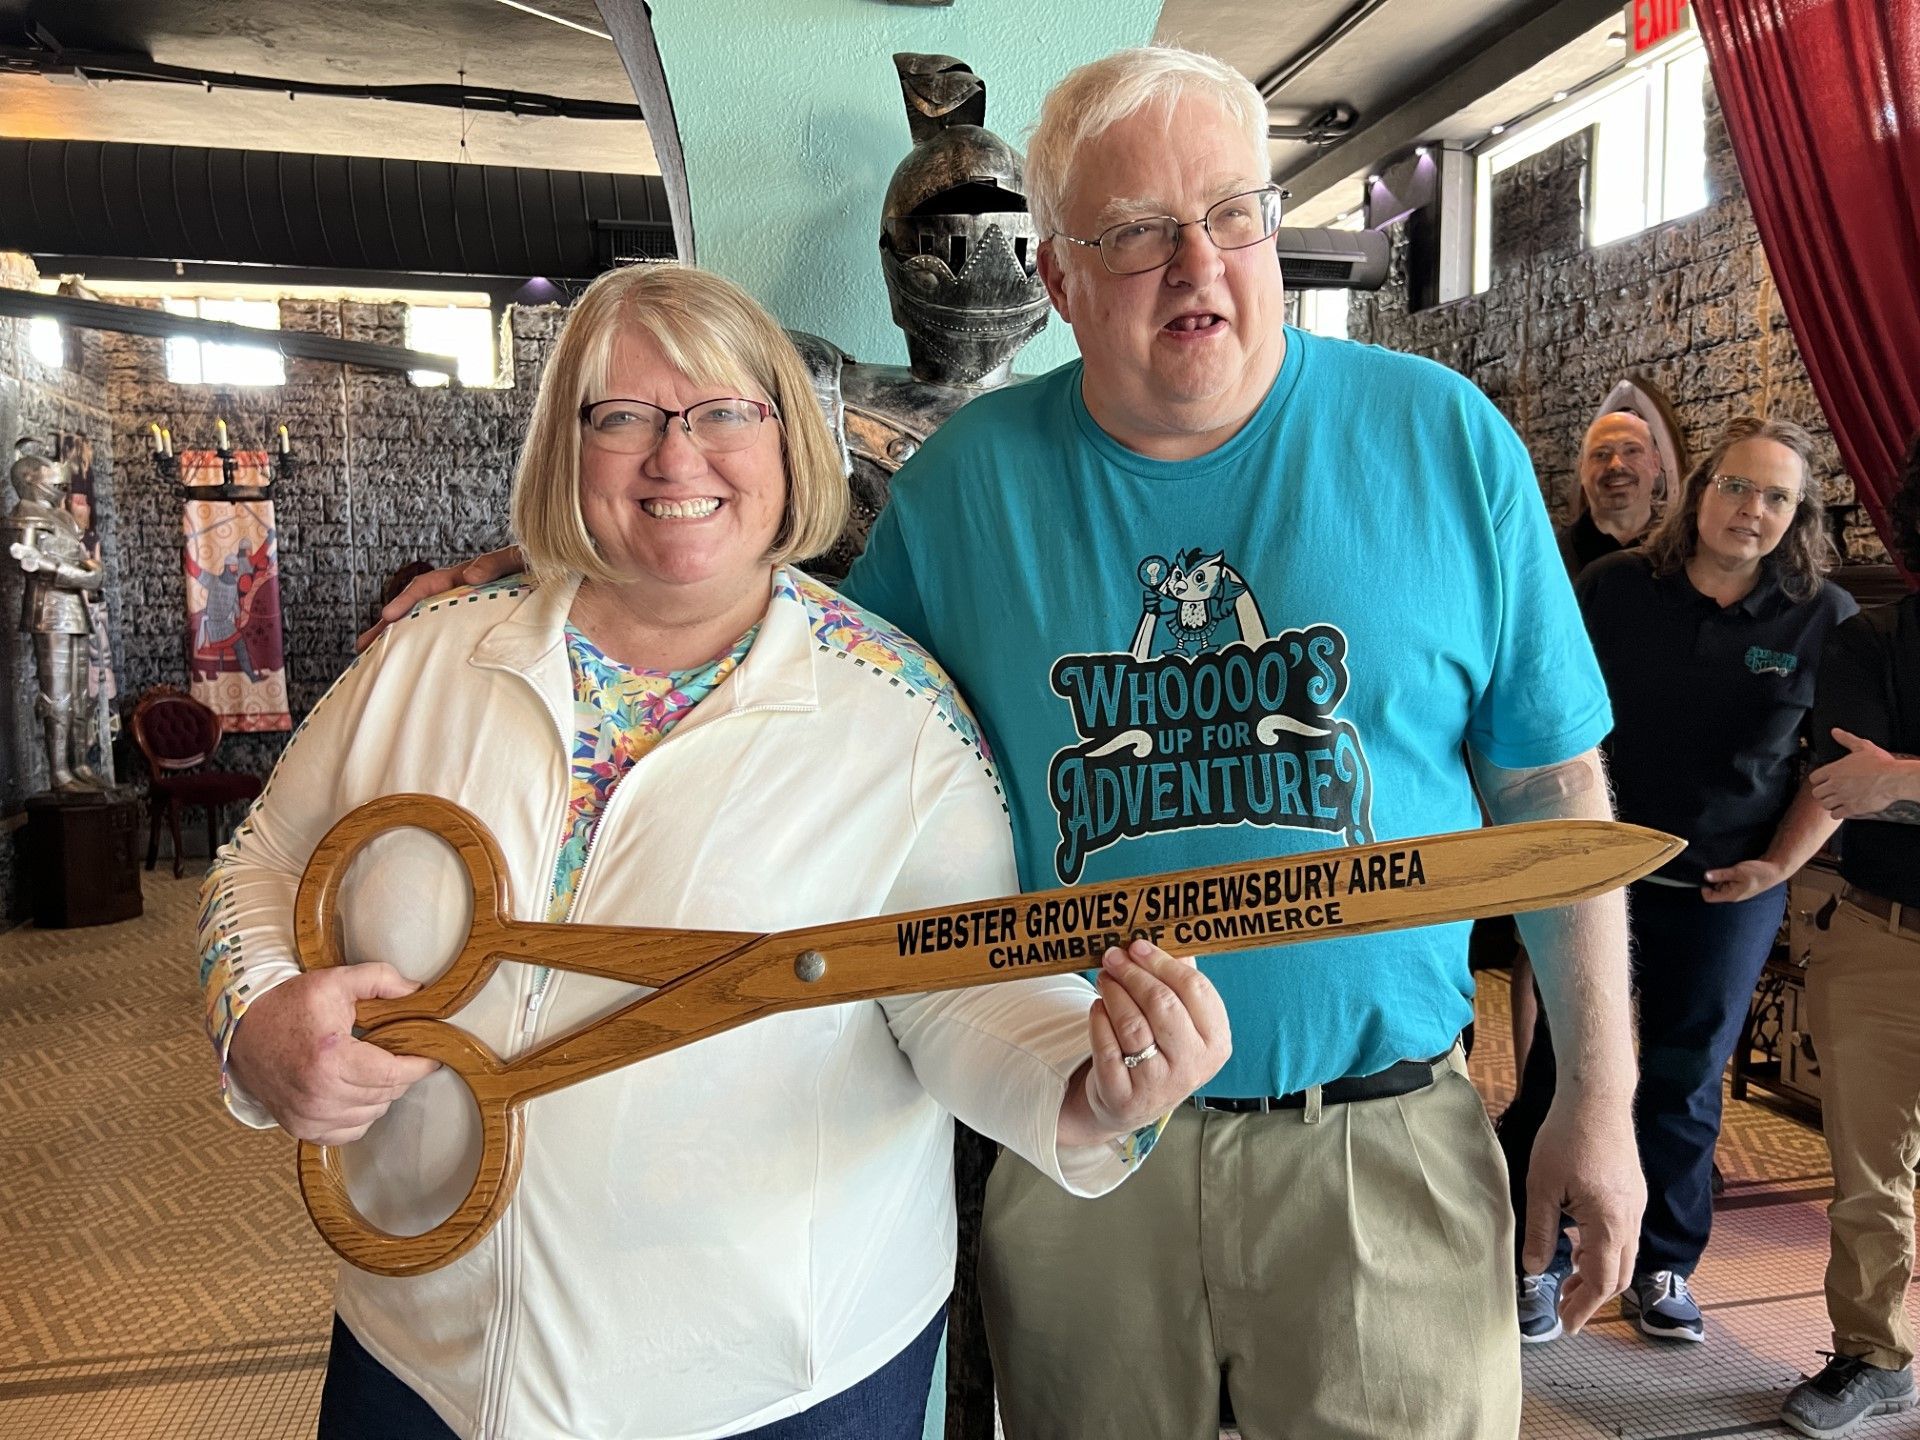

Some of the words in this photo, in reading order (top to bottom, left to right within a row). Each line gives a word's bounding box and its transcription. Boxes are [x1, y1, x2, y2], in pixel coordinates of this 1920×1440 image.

[1633, 0, 1687, 52] EXIT
[1060, 636, 1337, 729] WHOOOO'S
[1158, 727, 1192, 754] UP
[1202, 722, 1251, 752] FOR
[1057, 732, 1366, 873] ADVENTURE?
[897, 907, 1017, 956] WEBSTER
[1348, 850, 1426, 895] AREA
[989, 931, 1121, 969] CHAMBER
[1174, 902, 1343, 944] COMMERCE
